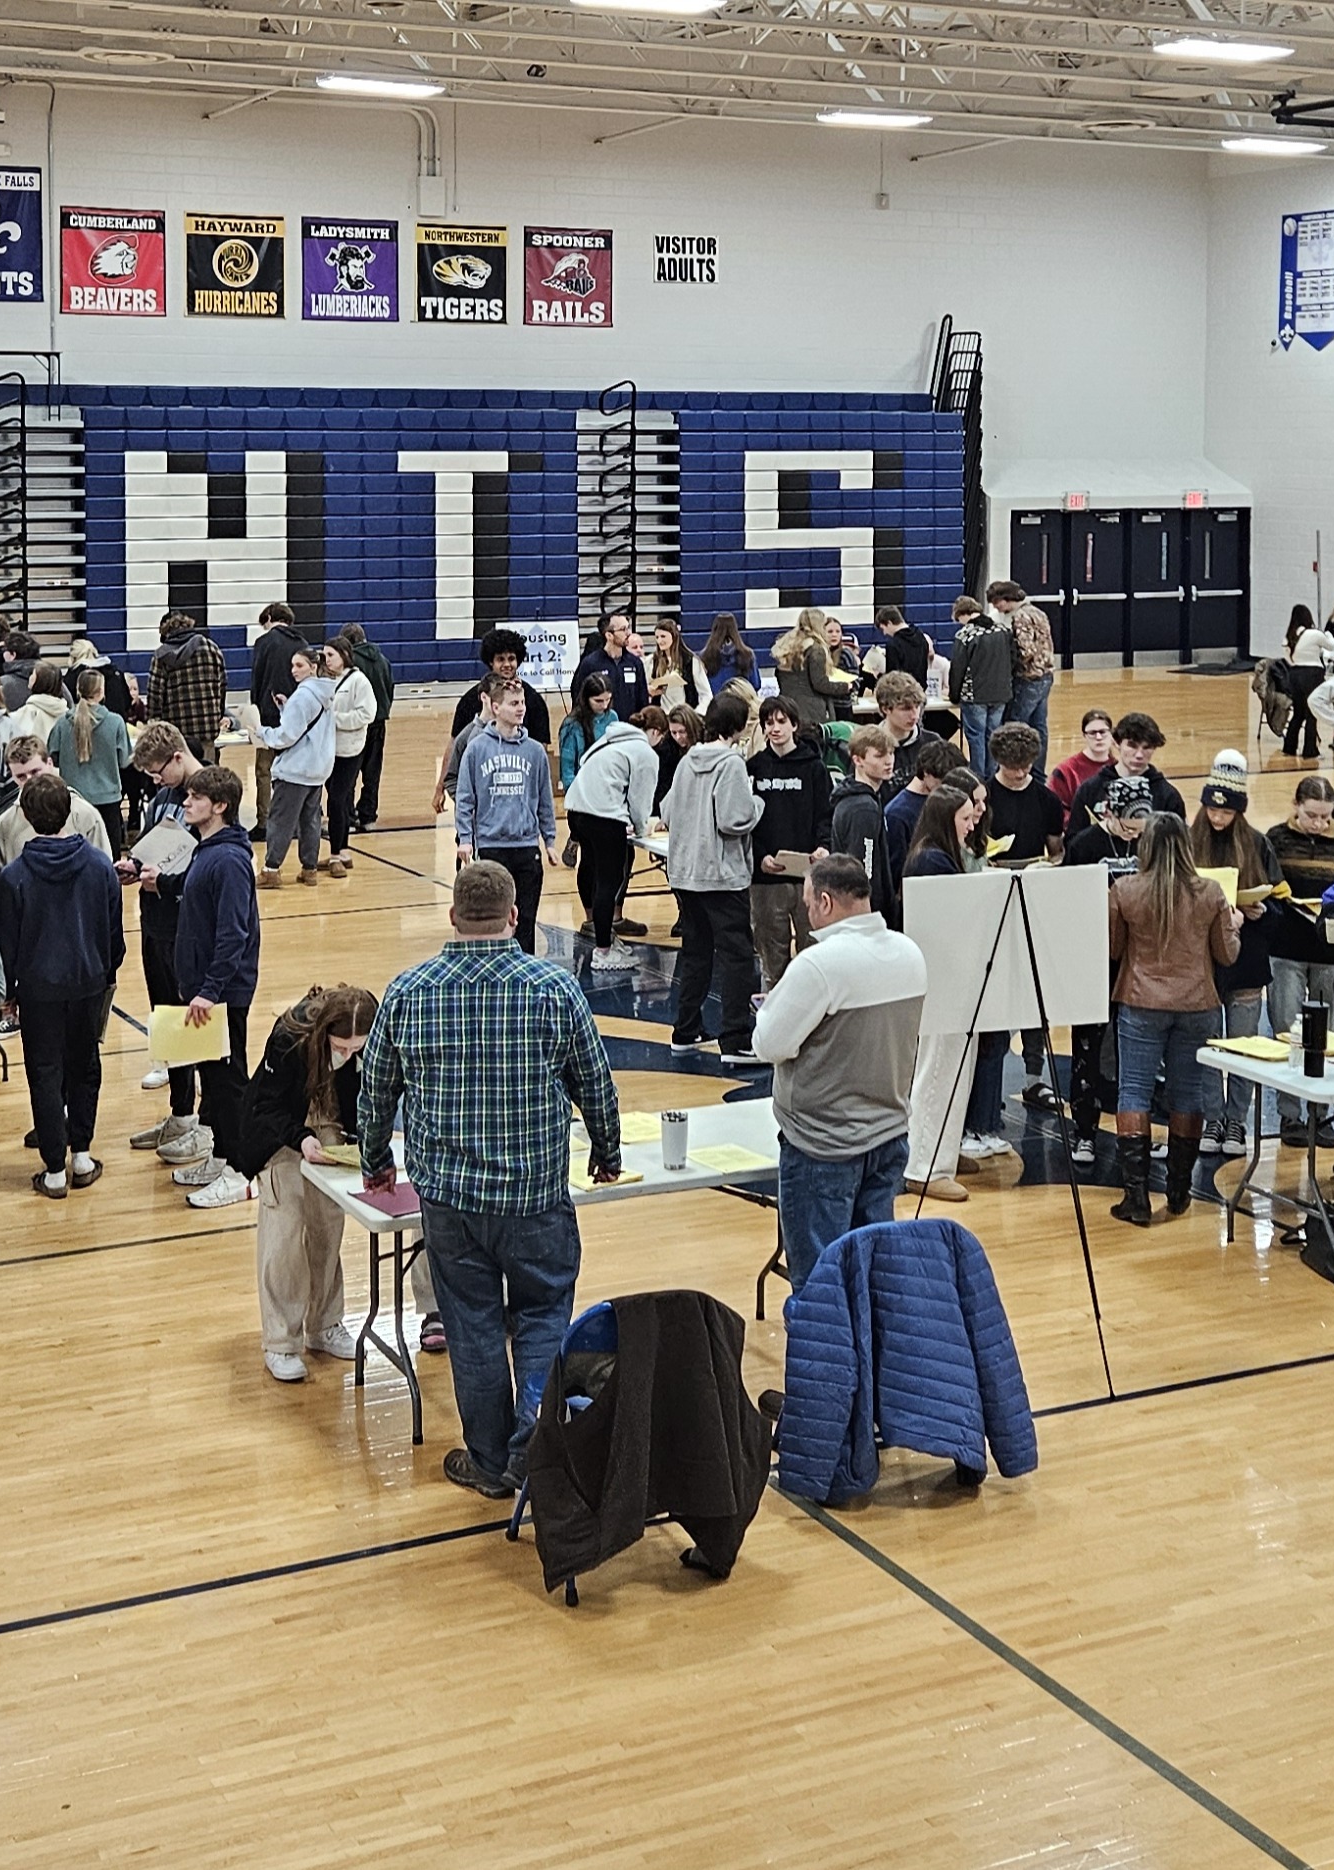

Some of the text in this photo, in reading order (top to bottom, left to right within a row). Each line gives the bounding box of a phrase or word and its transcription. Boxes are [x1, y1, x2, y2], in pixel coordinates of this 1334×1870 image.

[5, 176, 34, 187] FALLS
[69, 214, 156, 231] CUMBERLAND
[194, 220, 277, 234] HAYWARD
[310, 225, 390, 240] LADYSMITH
[424, 230, 500, 243] NORTHWESTERN
[531, 234, 605, 248] SPOONER
[655, 235, 716, 255] VISITOR
[657, 257, 715, 283] ADULTS
[69, 286, 157, 312] BEAVERS
[194, 290, 278, 315] HURRICANES
[310, 293, 391, 318] LUMBERJACKS
[420, 296, 503, 321] TIGERS
[532, 299, 605, 323] RAILS
[521, 631, 567, 646] ousing
[548, 650, 562, 662] 2:
[540, 668, 555, 676] Call
[480, 754, 532, 778] NASHVILLE
